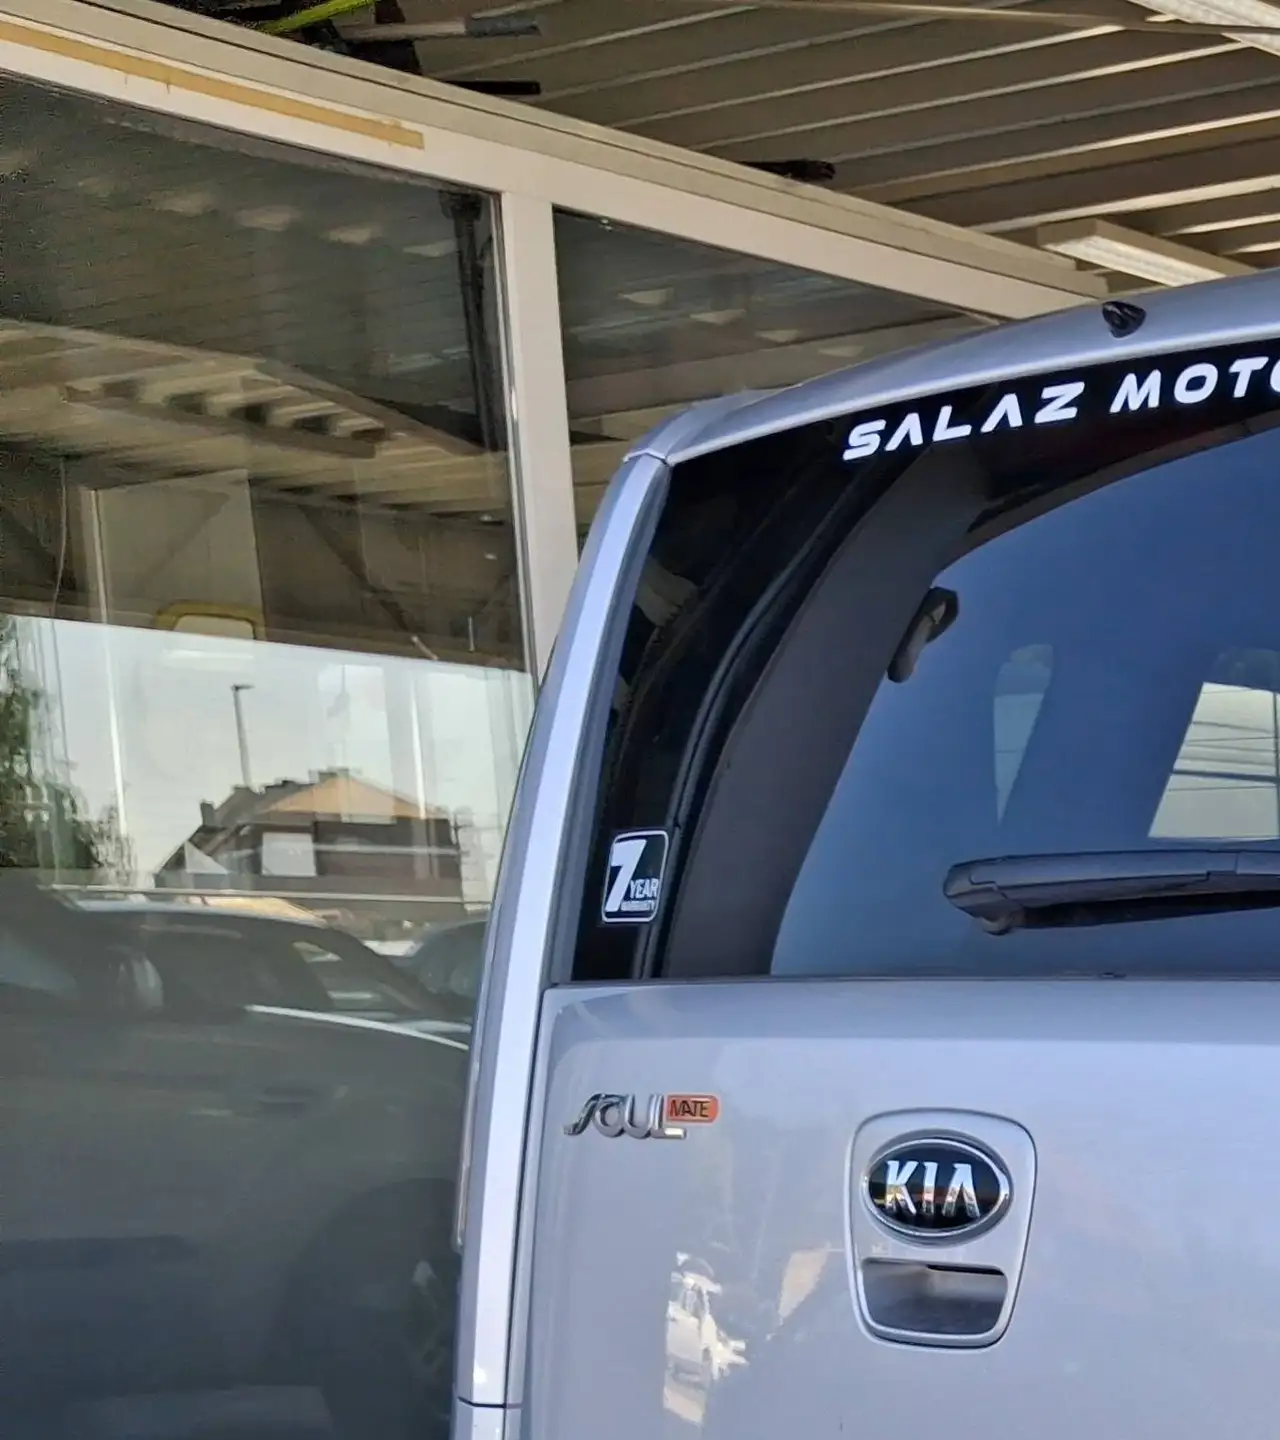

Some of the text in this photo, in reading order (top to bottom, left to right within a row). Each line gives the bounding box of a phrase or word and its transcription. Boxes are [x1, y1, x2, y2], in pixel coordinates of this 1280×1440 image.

[842, 381, 1086, 462] SALAZ
[604, 838, 647, 912] 7
[629, 877, 660, 899] YEAR
[669, 1099, 710, 1118] MATE
[884, 1159, 982, 1219] KIA
